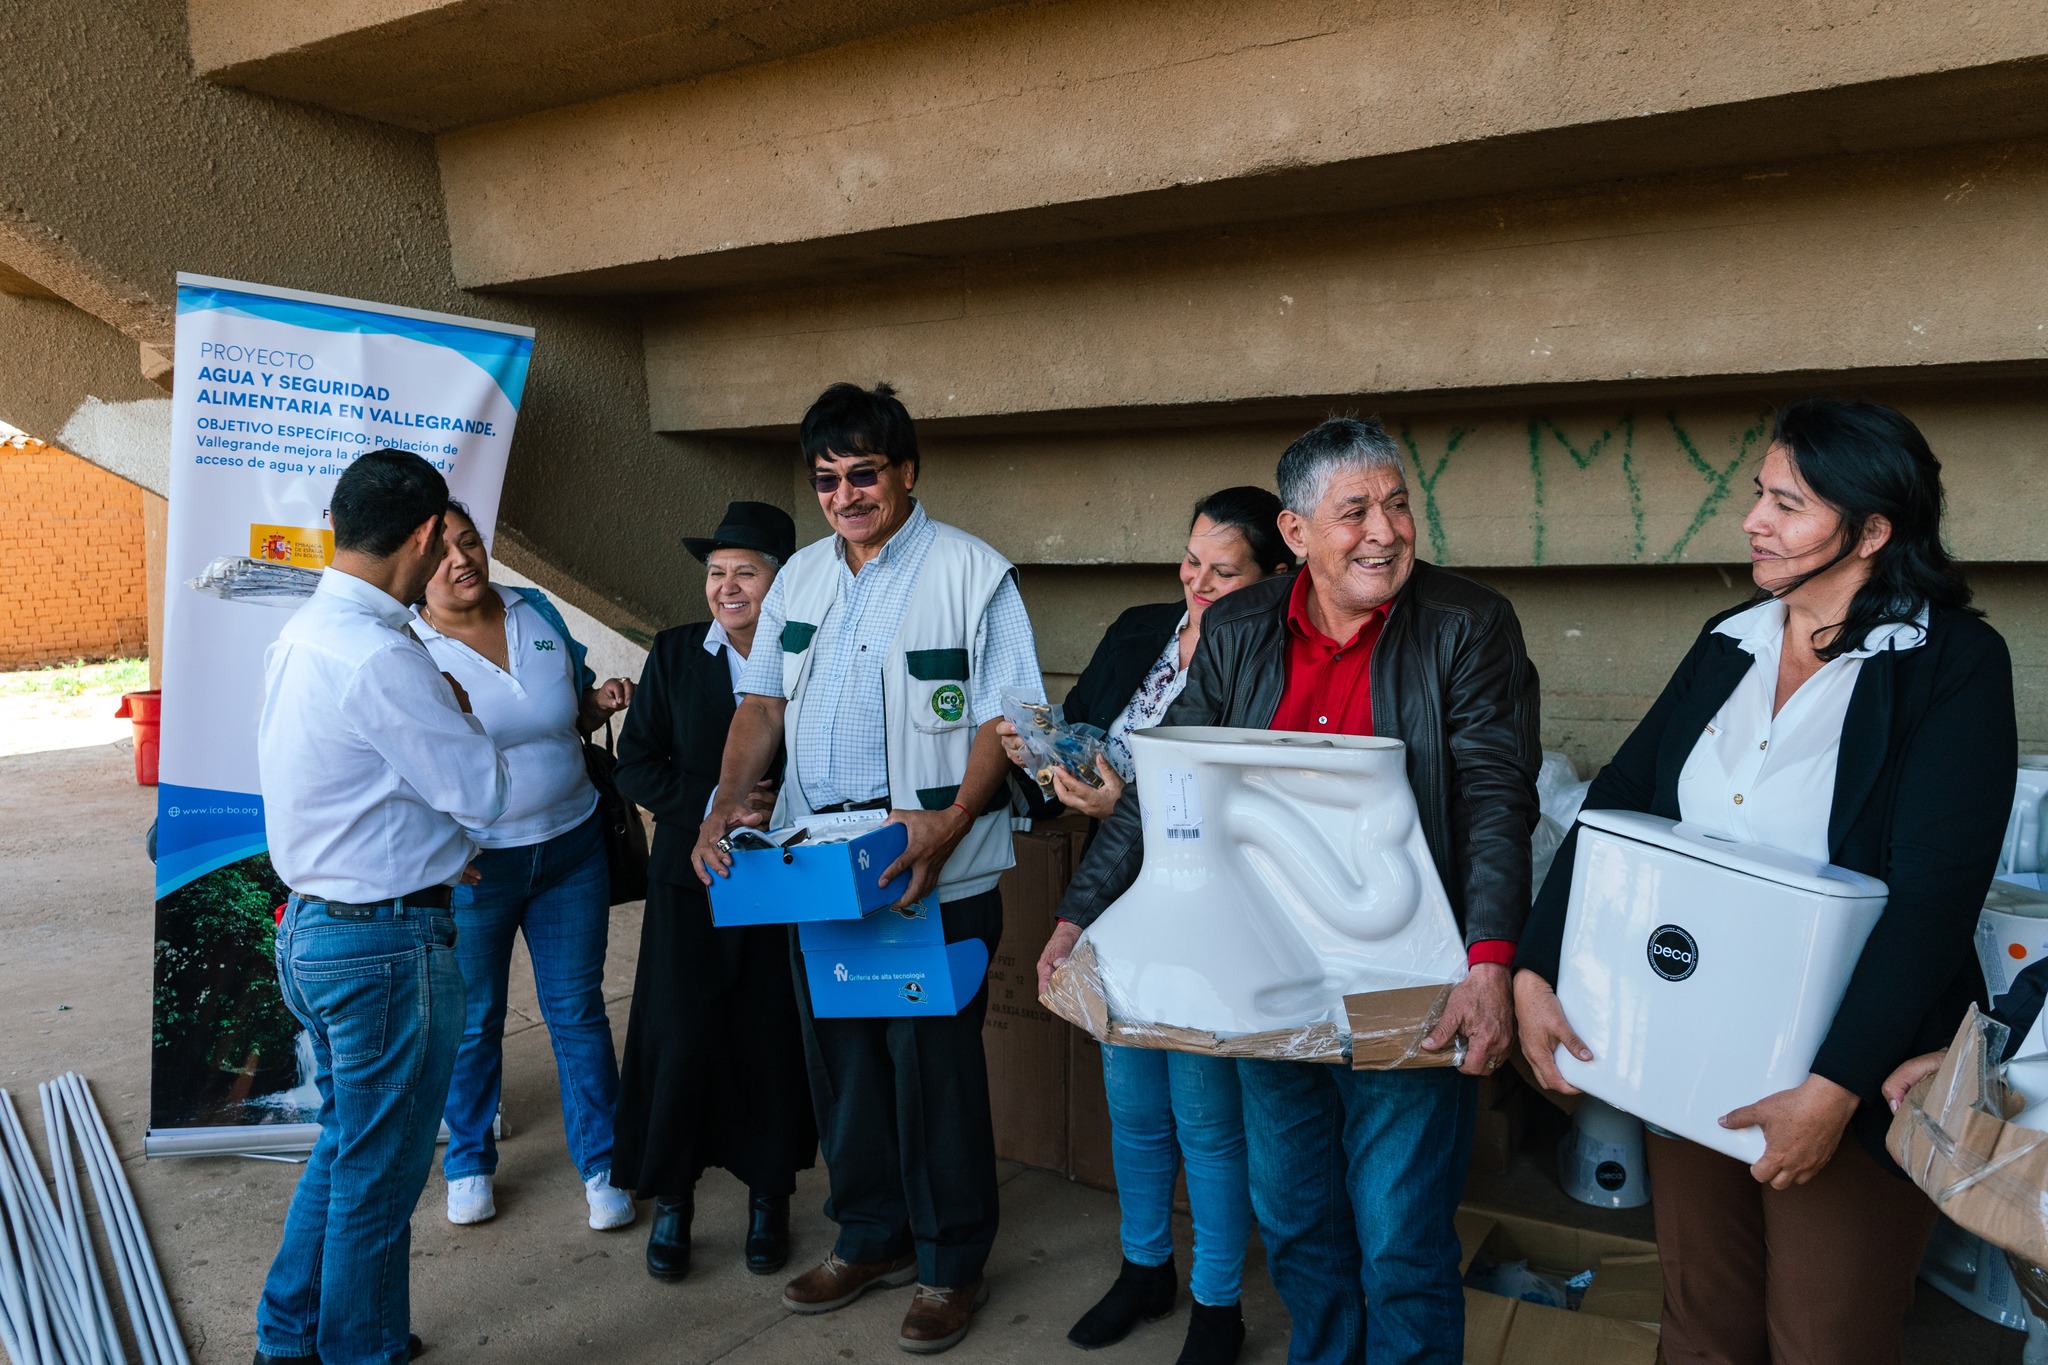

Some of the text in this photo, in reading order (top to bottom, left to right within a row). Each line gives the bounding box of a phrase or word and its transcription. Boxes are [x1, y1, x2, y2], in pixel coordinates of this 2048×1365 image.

[201, 342, 314, 370] PROYECTO
[198, 366, 390, 401] AGUA Y SEGURIDAD
[197, 389, 497, 437] ALIMENTARIA EN VALLEGRANDE.
[197, 417, 459, 455] OBJETIVO ESPECÍFICO: Población de
[196, 455, 244, 467] acceso
[248, 457, 265, 468] de
[269, 461, 303, 473] agua
[308, 465, 316, 475] y
[197, 434, 280, 453] Vallegrande
[284, 444, 332, 459] mejora
[336, 448, 348, 460] la
[448, 463, 455, 473] y
[182, 806, 258, 816] www.ico-bo.org
[871, 973, 880, 981] de
